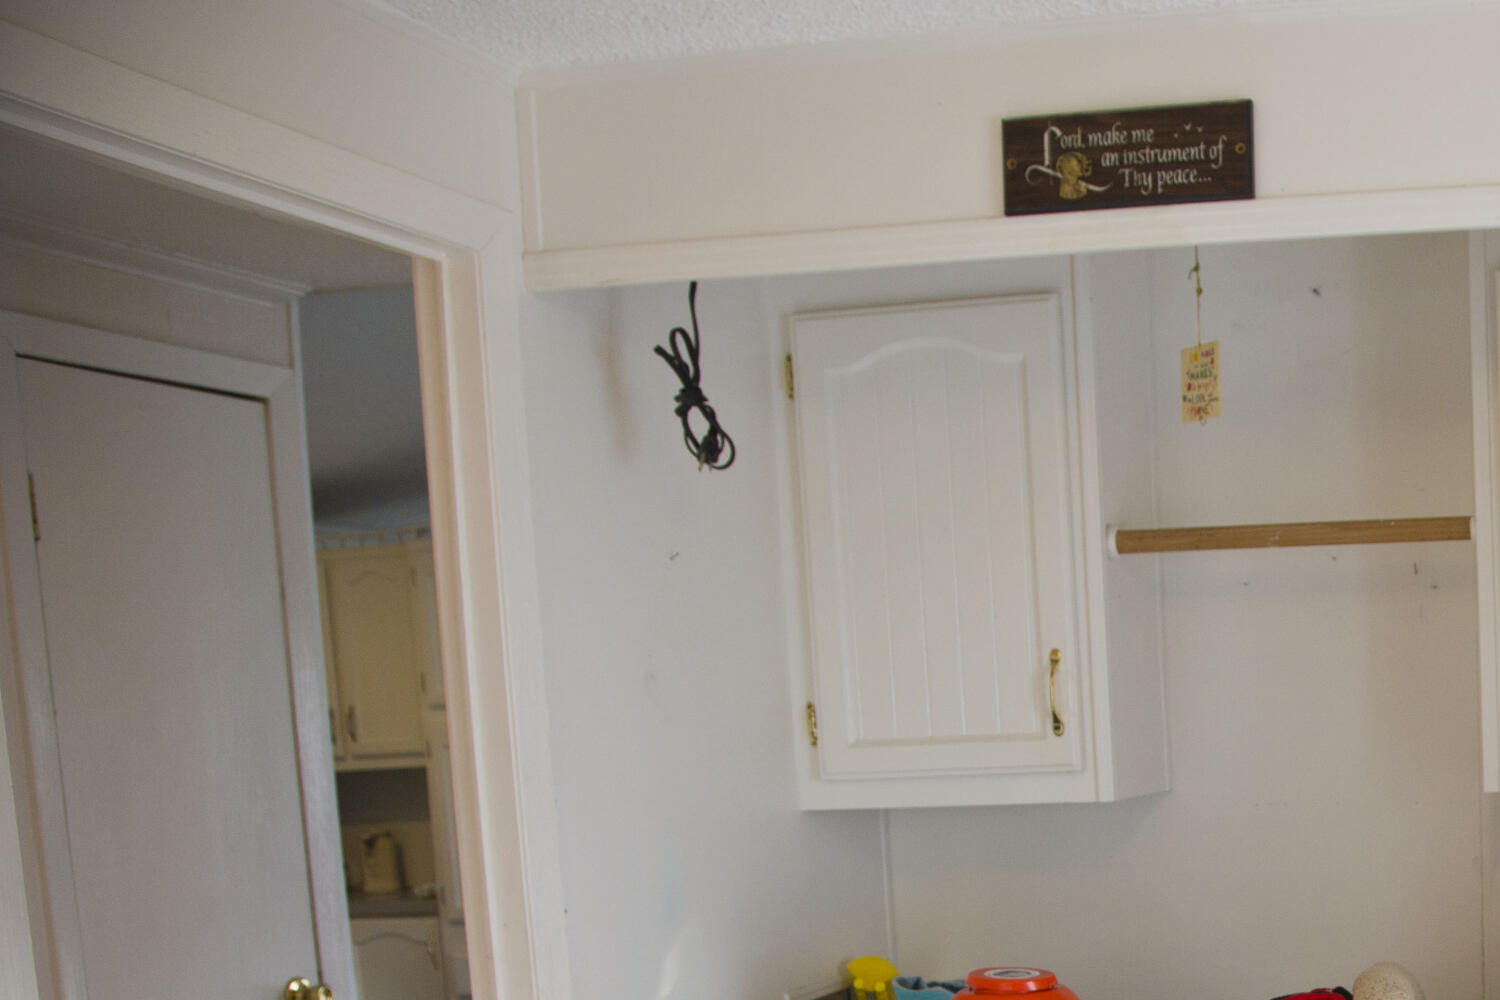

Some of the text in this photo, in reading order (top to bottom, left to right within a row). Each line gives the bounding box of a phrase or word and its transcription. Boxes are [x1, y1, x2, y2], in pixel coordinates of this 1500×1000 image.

[1087, 121, 1128, 147] make
[1131, 127, 1155, 144] me
[1101, 134, 1228, 169] an instrument of
[1118, 167, 1213, 196] Thy peace...
